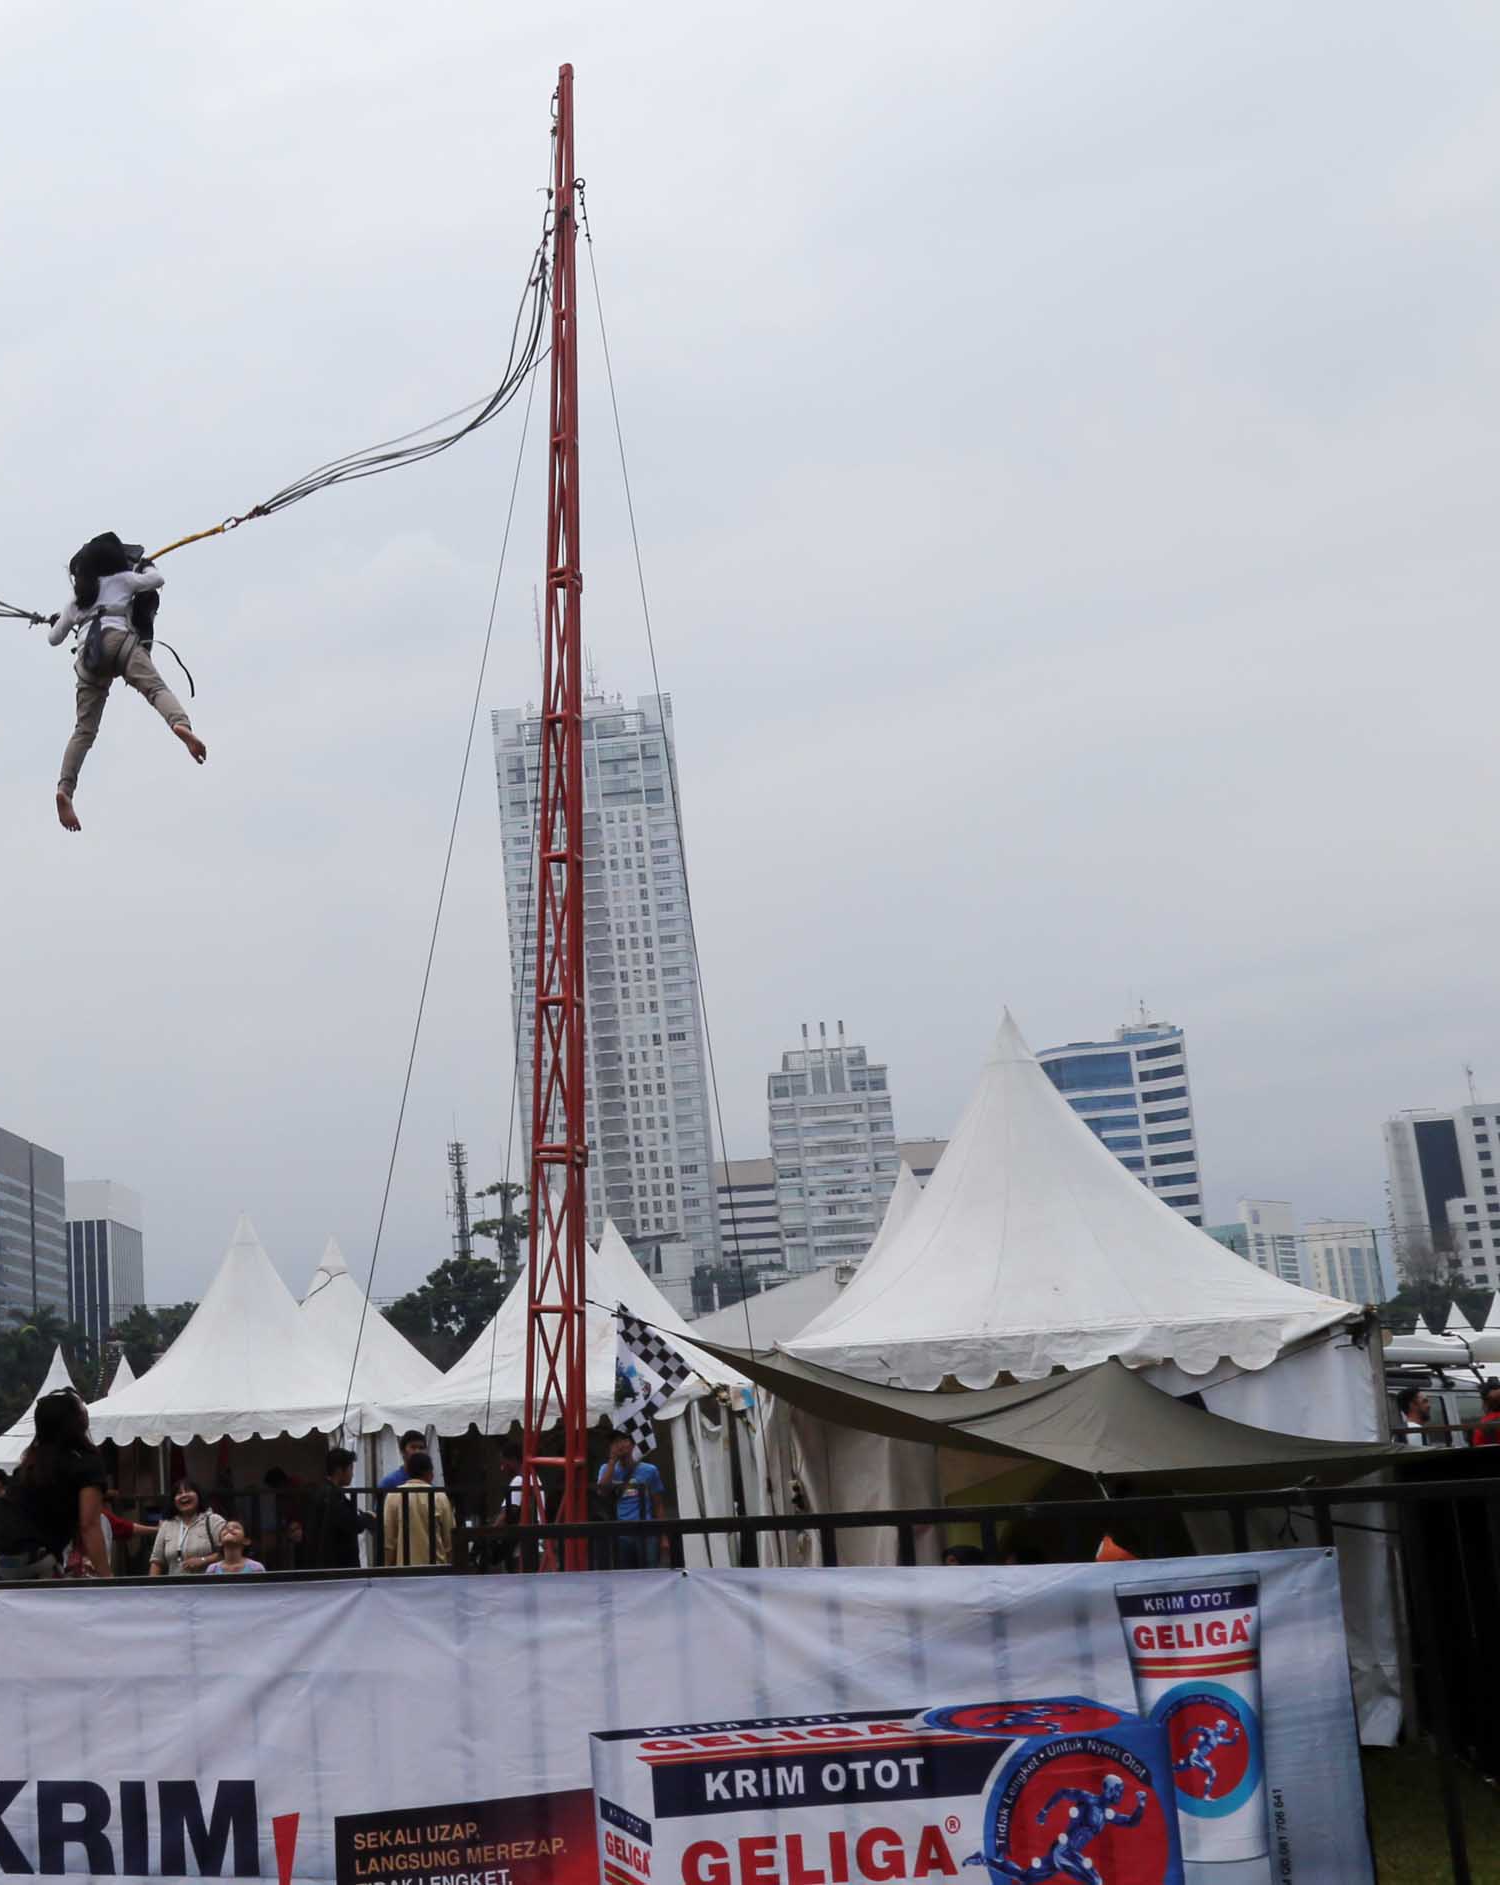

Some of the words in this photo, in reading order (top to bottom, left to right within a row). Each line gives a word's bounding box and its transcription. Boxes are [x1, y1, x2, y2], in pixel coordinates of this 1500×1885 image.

[1143, 1596, 1184, 1612] KRIM
[1190, 1592, 1232, 1608] OTOT
[704, 1766, 806, 1801] KRIM
[821, 1757, 925, 1792] OTOT
[996, 1801, 1010, 1847] Tidak
[1003, 1757, 1040, 1805] Lengket
[1046, 1739, 1083, 1757] Untuk
[1121, 1752, 1148, 1779] Otot
[354, 1826, 421, 1850] SEKALI
[355, 1850, 461, 1876] LANGSUNG
